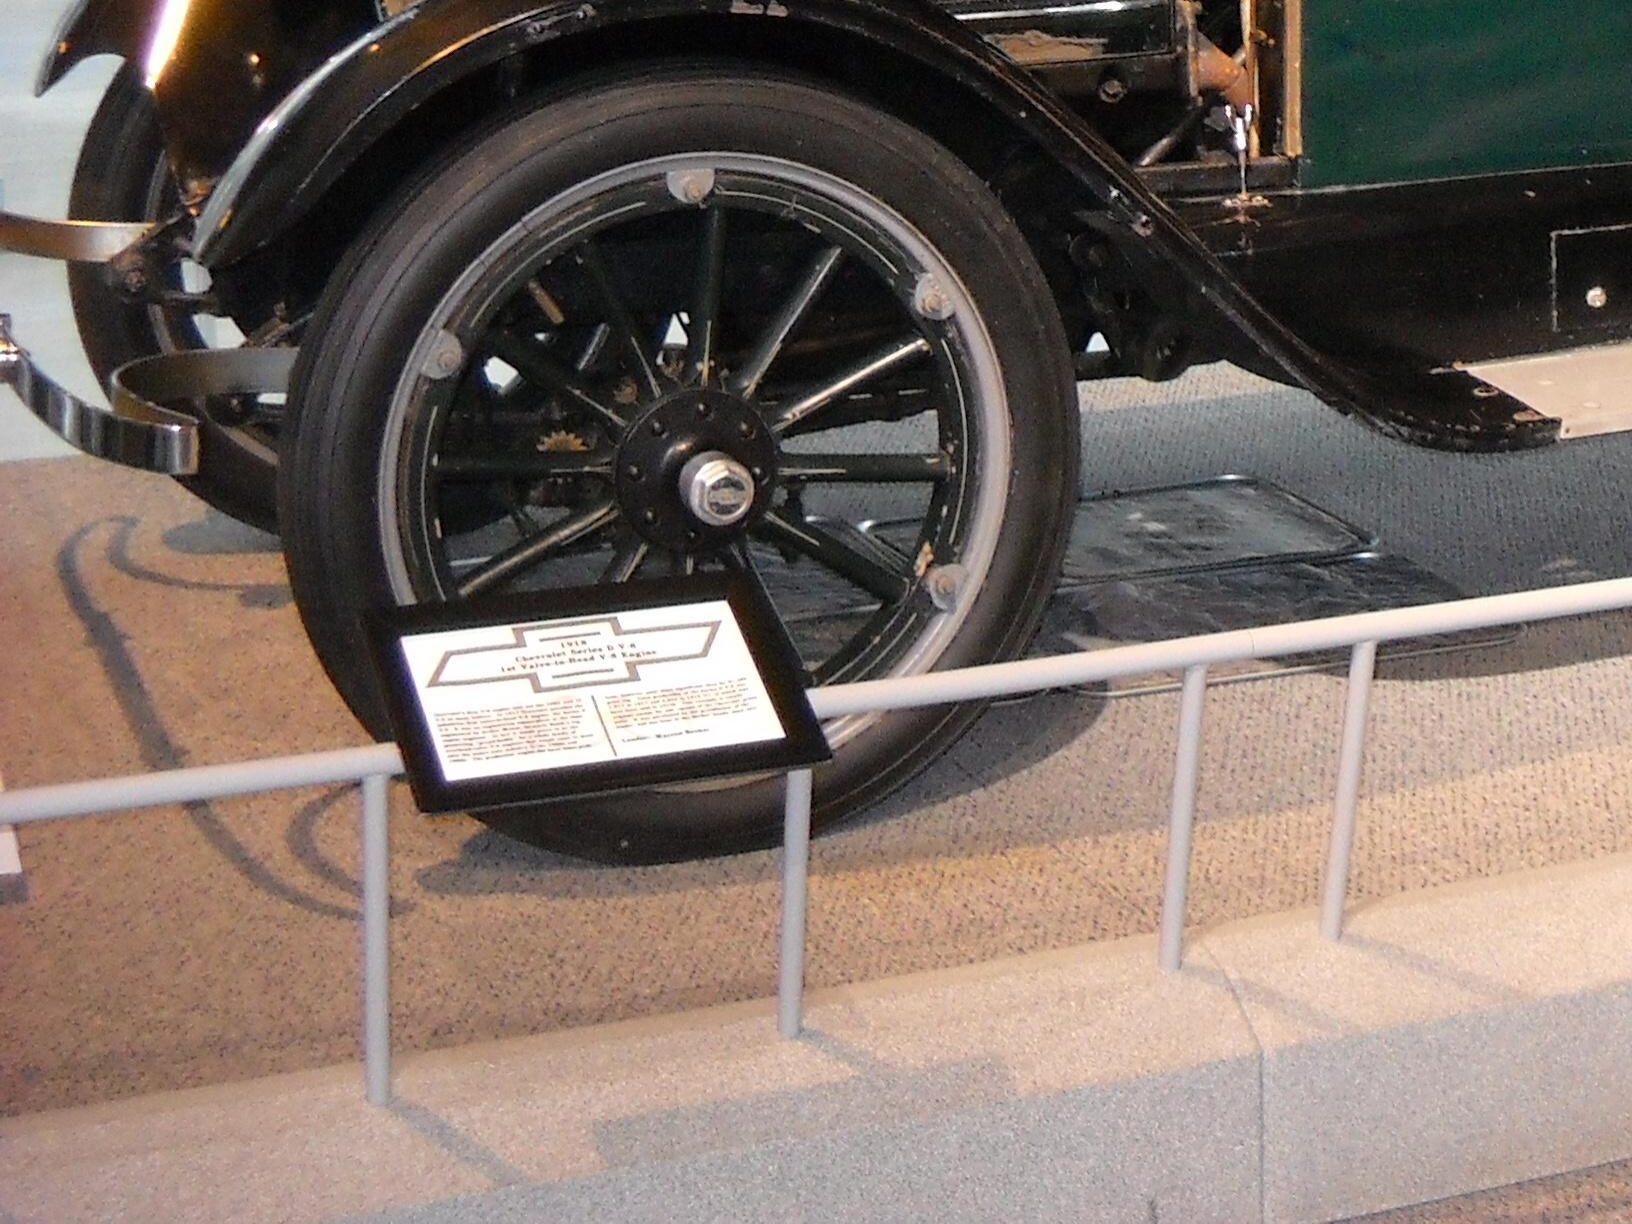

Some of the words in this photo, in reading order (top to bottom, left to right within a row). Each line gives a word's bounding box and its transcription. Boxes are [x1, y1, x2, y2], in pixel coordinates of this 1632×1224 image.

[515, 651, 566, 663] Chevrolet
[570, 647, 603, 655] Series
[621, 650, 657, 659] Engine
